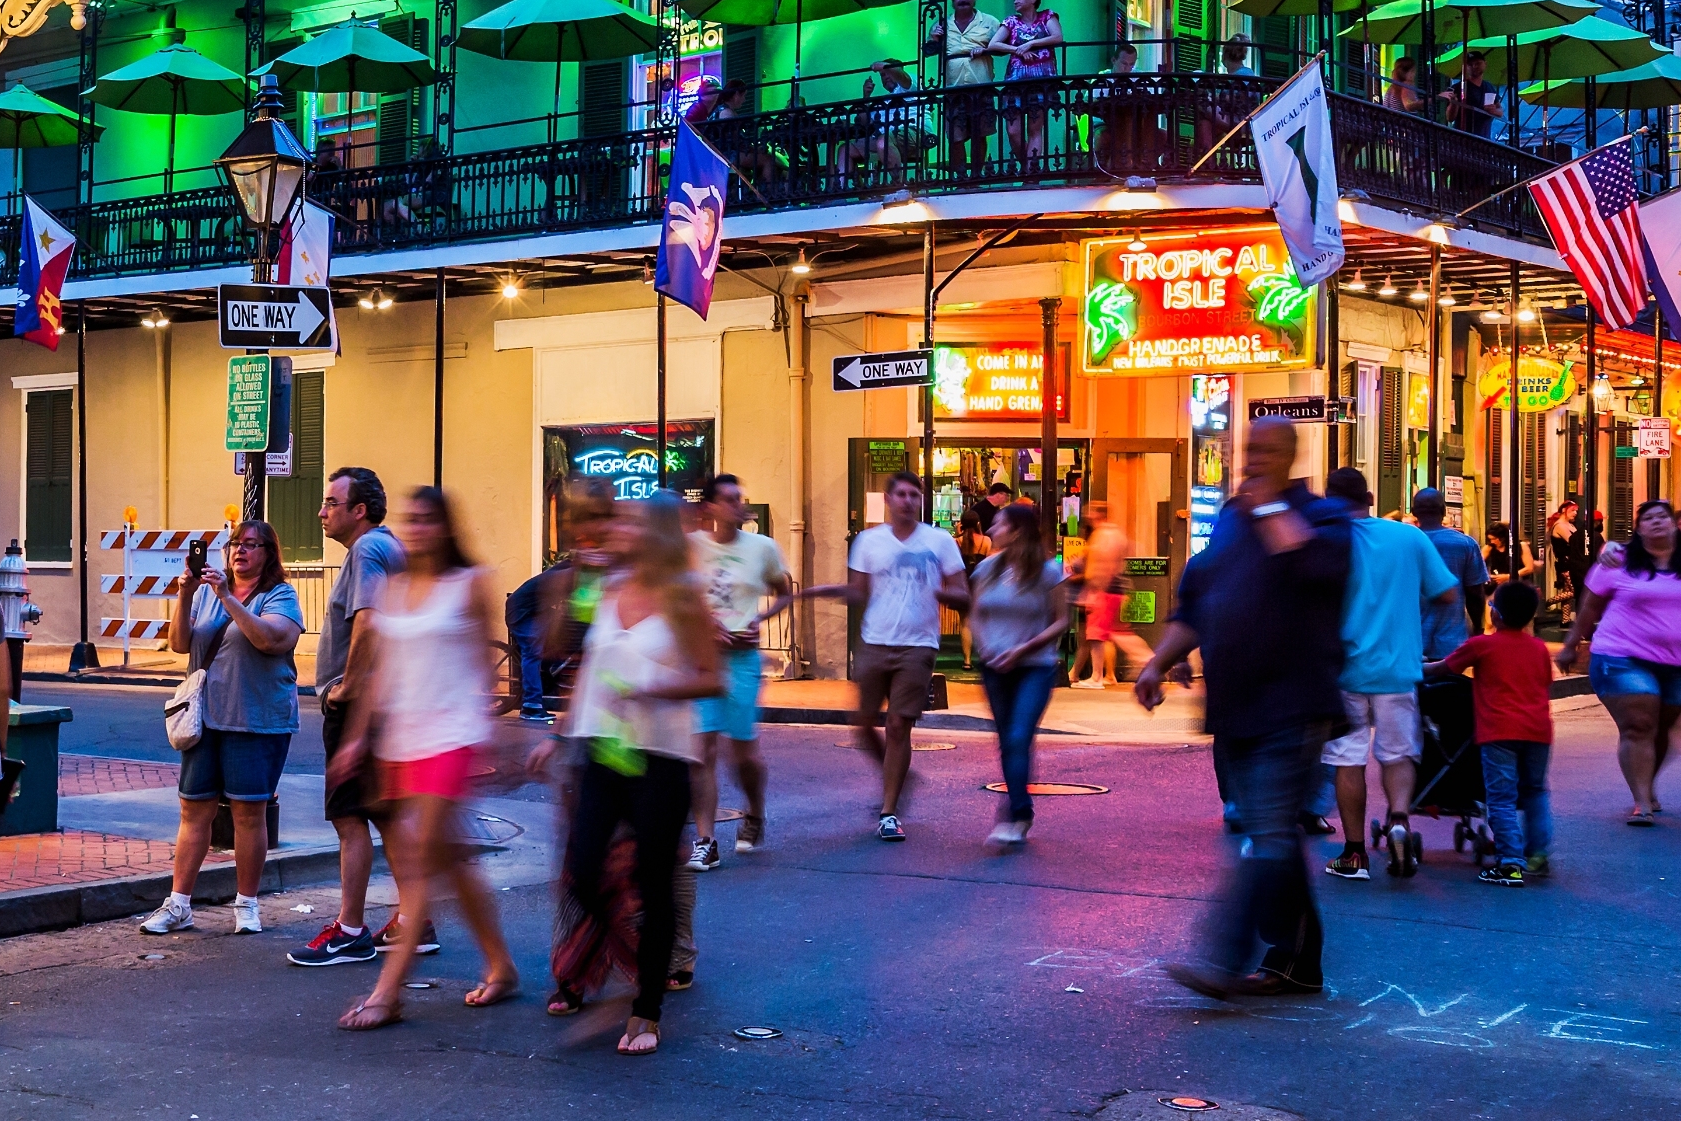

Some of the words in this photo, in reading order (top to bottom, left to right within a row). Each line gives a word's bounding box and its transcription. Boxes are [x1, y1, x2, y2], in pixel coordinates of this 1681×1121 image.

[1262, 108, 1300, 143] TROPICAL
[1119, 244, 1276, 282] TROPICAL
[1302, 254, 1327, 273] HAND
[1162, 278, 1226, 310] ISLE
[231, 303, 259, 328] ONE
[264, 305, 296, 329] WAY
[1138, 311, 1200, 327] BOURBON
[1206, 308, 1257, 325] STREET
[977, 355, 1010, 370] COME
[1014, 355, 1028, 370] IN
[1113, 357, 1133, 369] NEW
[1134, 356, 1174, 368] ORLEANS
[1178, 355, 1205, 367] MOST
[1206, 351, 1253, 366] POWERFUL
[1253, 350, 1282, 364] DRINK
[232, 365, 241, 374] NO
[241, 363, 266, 373] BOTTLES
[862, 364, 889, 379] ONE
[895, 361, 924, 376] WAY
[235, 374, 243, 383] OR
[244, 373, 263, 382] GLASS
[990, 376, 1028, 391] DRINK
[1030, 377, 1039, 391] A
[236, 382, 262, 392] ALLOWED
[233, 392, 241, 401] ON
[242, 391, 264, 400] STREET
[970, 396, 1003, 411] HAND
[1008, 395, 1062, 411] GRENE
[1527, 395, 1548, 406] GO
[244, 405, 262, 413] DRINKS
[1254, 405, 1319, 418] Orleans
[241, 421, 260, 429] PLASTIC
[1641, 419, 1651, 428] NO
[233, 428, 261, 437] CONTAINERS
[1645, 439, 1664, 447] LANE
[574, 449, 659, 474] TROPICAL
